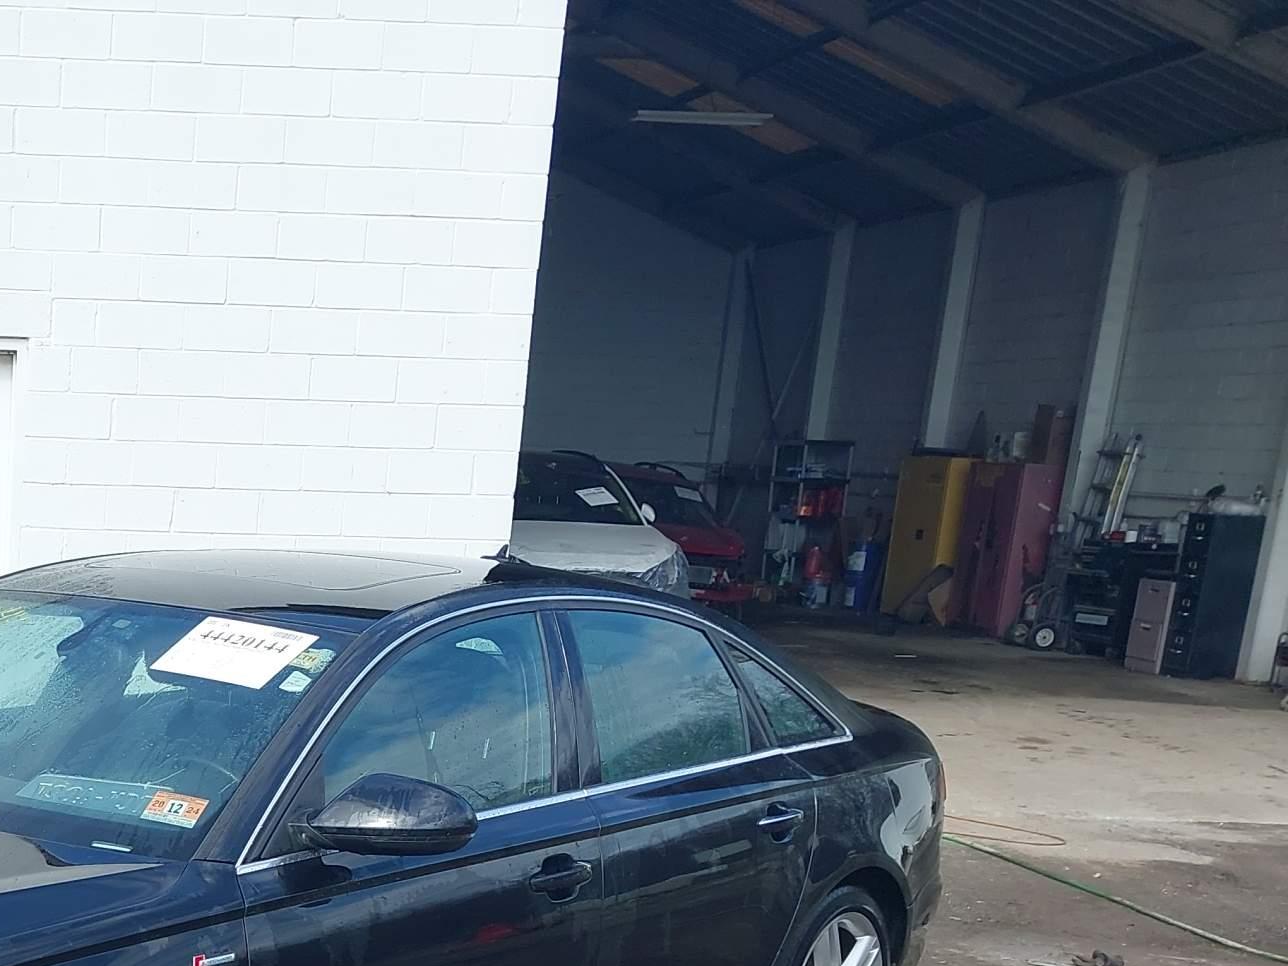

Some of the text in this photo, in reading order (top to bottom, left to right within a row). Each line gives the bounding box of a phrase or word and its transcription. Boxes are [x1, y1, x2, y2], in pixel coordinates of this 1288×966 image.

[200, 630, 290, 653] 44420144
[152, 799, 200, 815] 20 12 24
